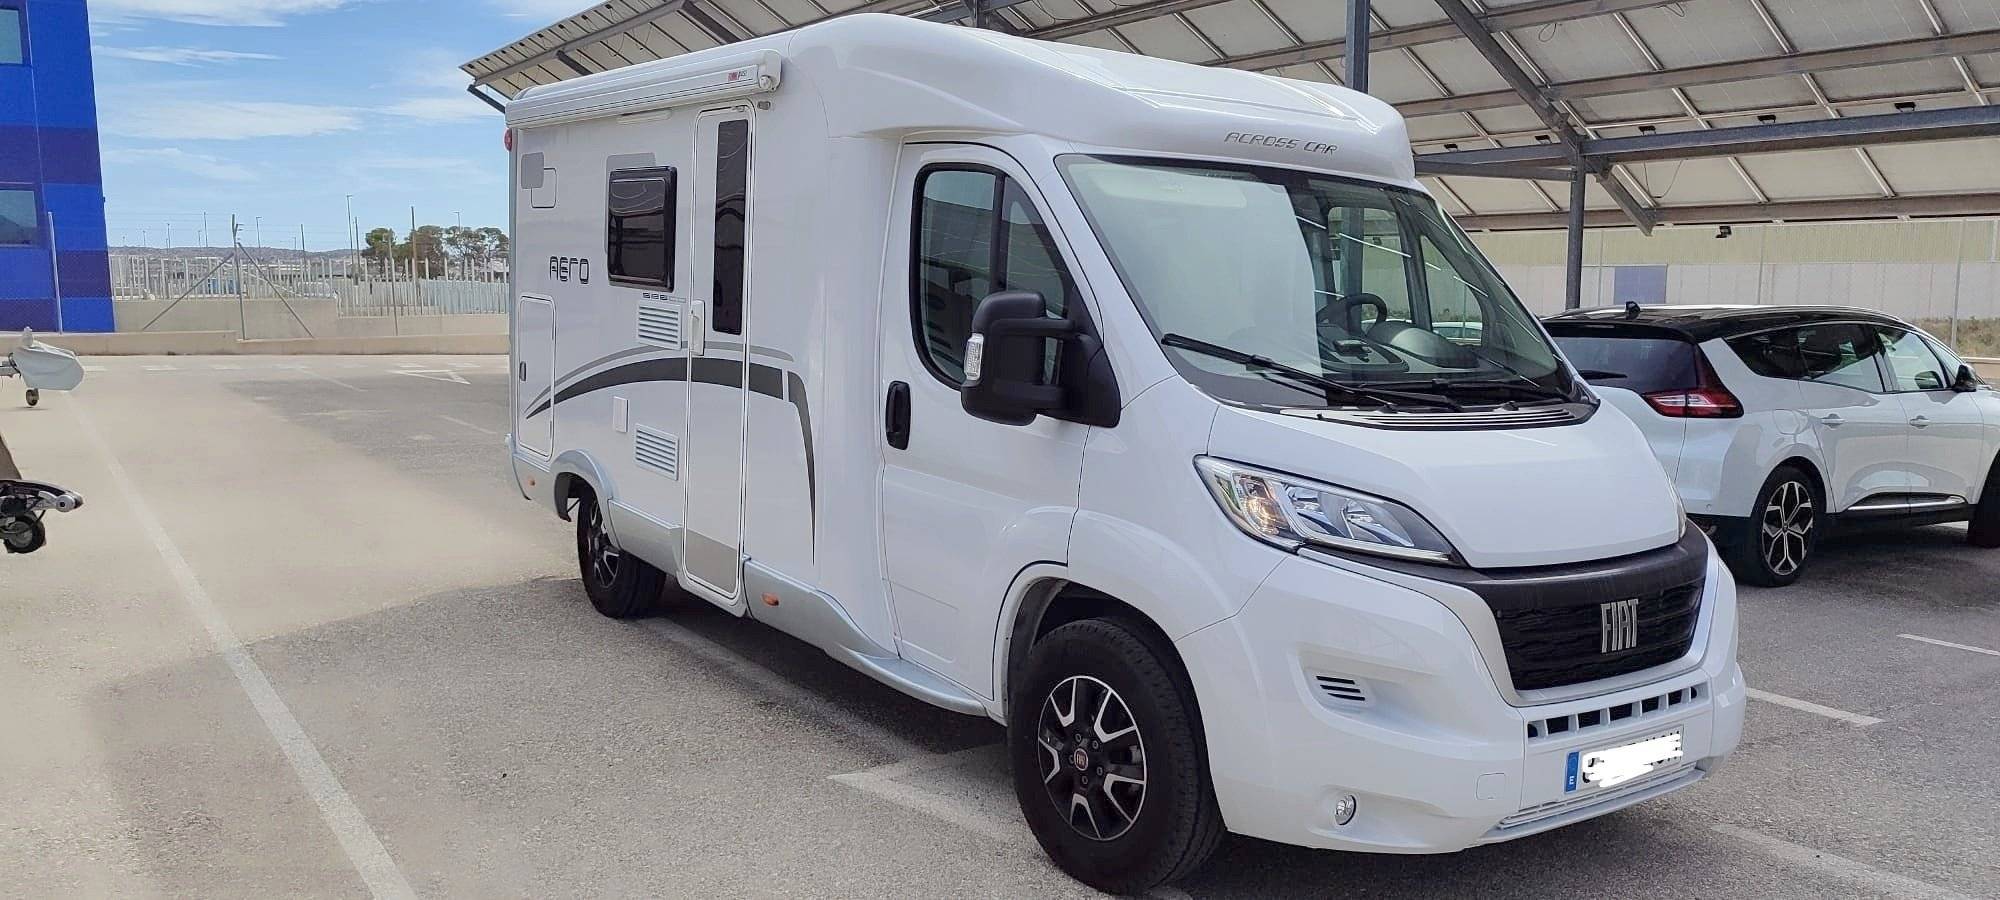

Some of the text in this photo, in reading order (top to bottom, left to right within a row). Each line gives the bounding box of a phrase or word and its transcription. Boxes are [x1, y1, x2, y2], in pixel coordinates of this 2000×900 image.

[1223, 132, 1338, 155] ACROSS CAR
[1600, 598, 1639, 653] FIAT
[1568, 775, 1575, 785] E
